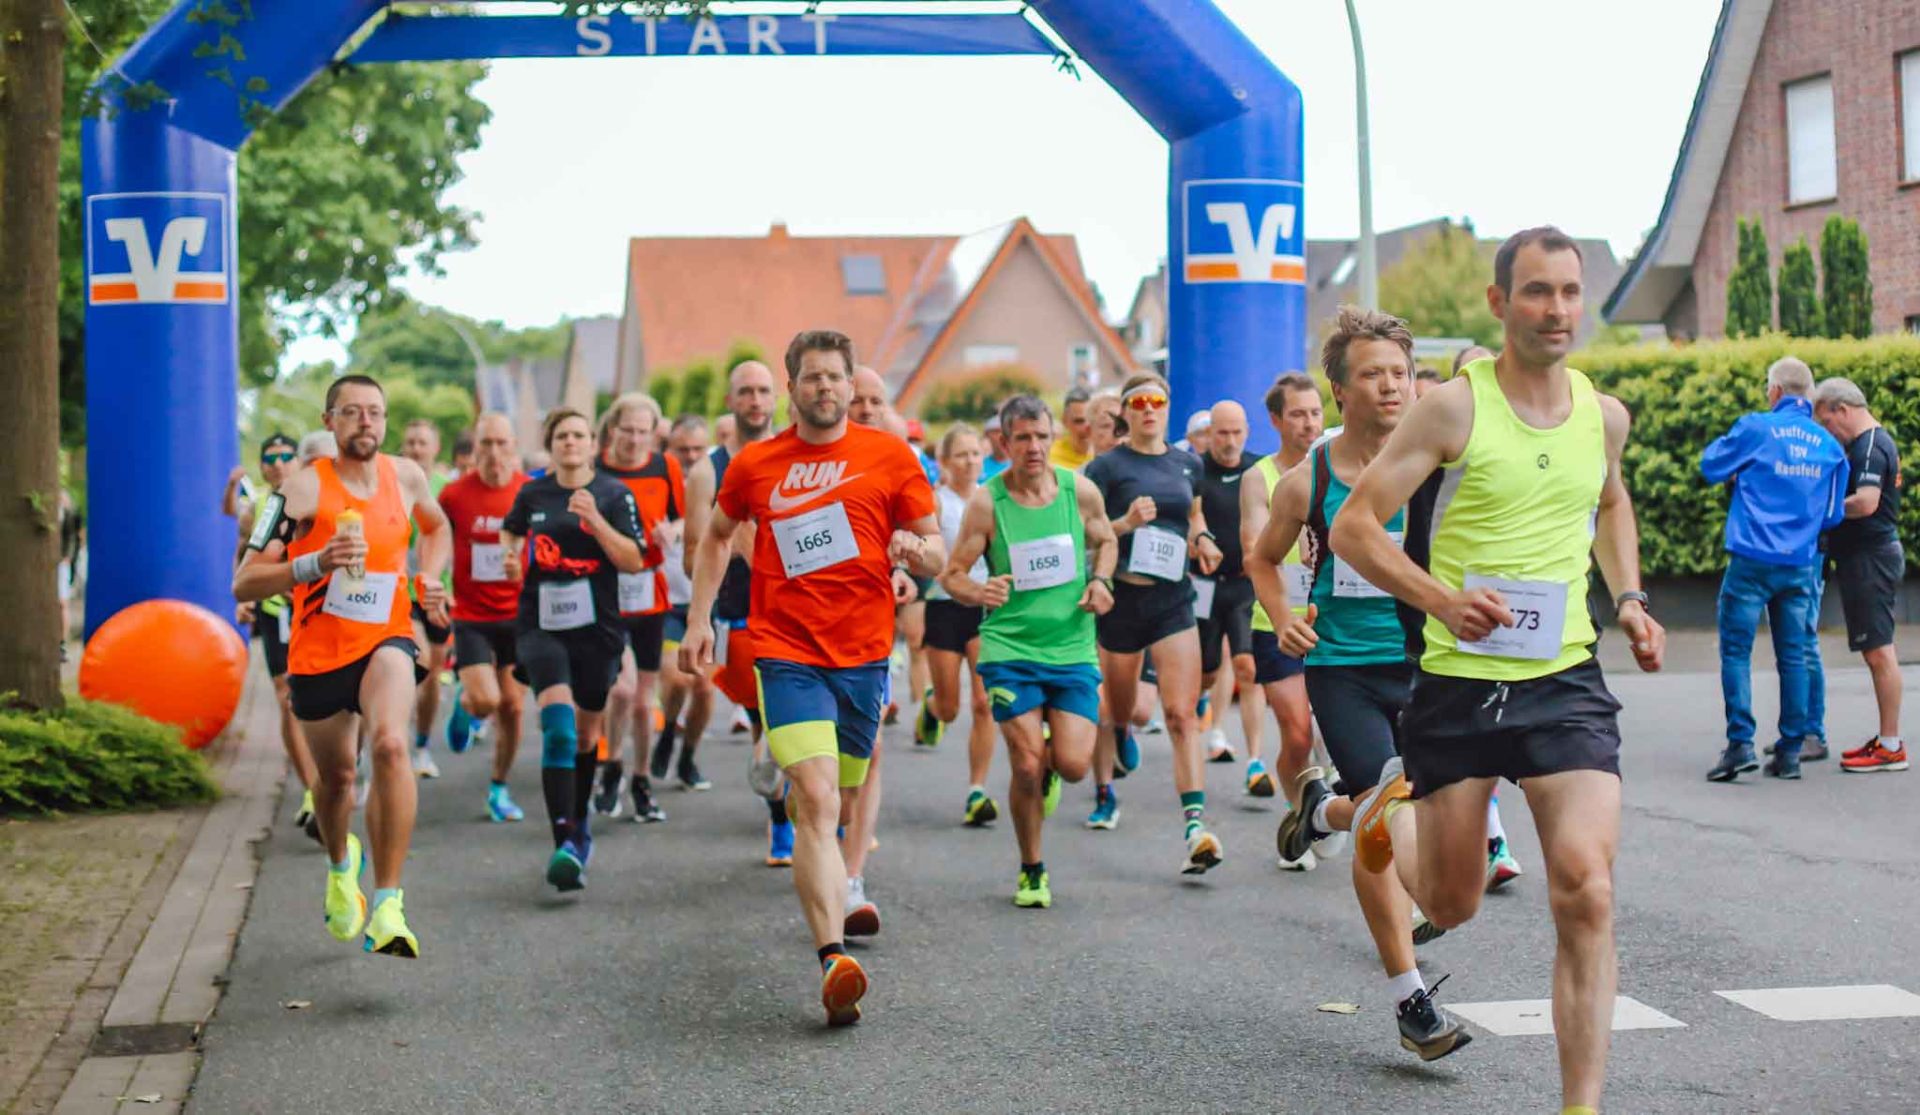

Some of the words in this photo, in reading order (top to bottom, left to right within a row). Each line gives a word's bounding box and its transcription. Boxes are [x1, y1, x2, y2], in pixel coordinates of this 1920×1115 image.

[576, 14, 838, 55] START
[1789, 444, 1808, 459] TSV
[783, 461, 848, 490] RUN
[795, 529, 832, 553] 1665
[1029, 555, 1060, 571] 1658
[1510, 608, 1540, 630] 73
